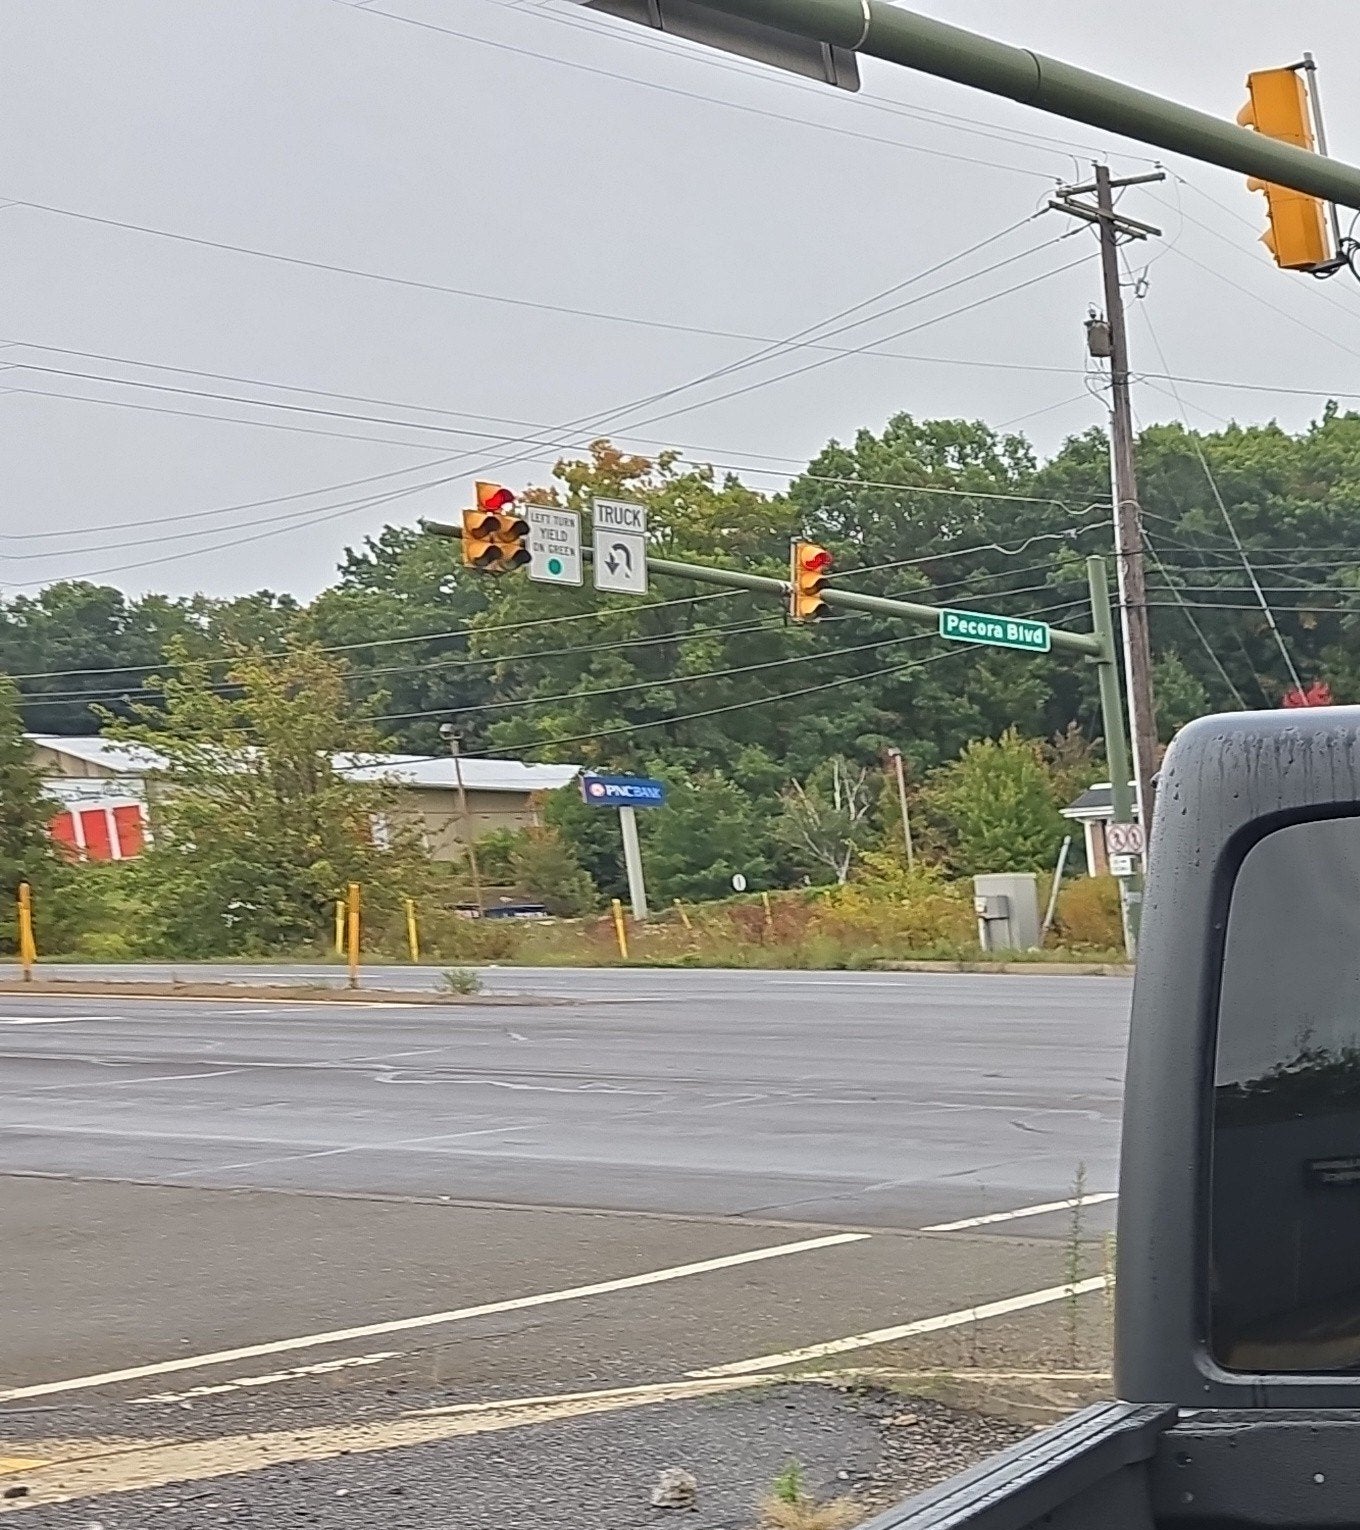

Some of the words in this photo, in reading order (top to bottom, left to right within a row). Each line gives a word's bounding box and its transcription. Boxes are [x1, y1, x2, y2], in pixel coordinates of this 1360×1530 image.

[531, 512, 551, 524] LEFT
[553, 514, 575, 527] TURN
[597, 504, 641, 527] TRUCK
[540, 528, 568, 542] YIELD
[548, 544, 576, 557] GREEN
[947, 615, 1003, 638] Pecora
[1006, 623, 1043, 644] Blvd
